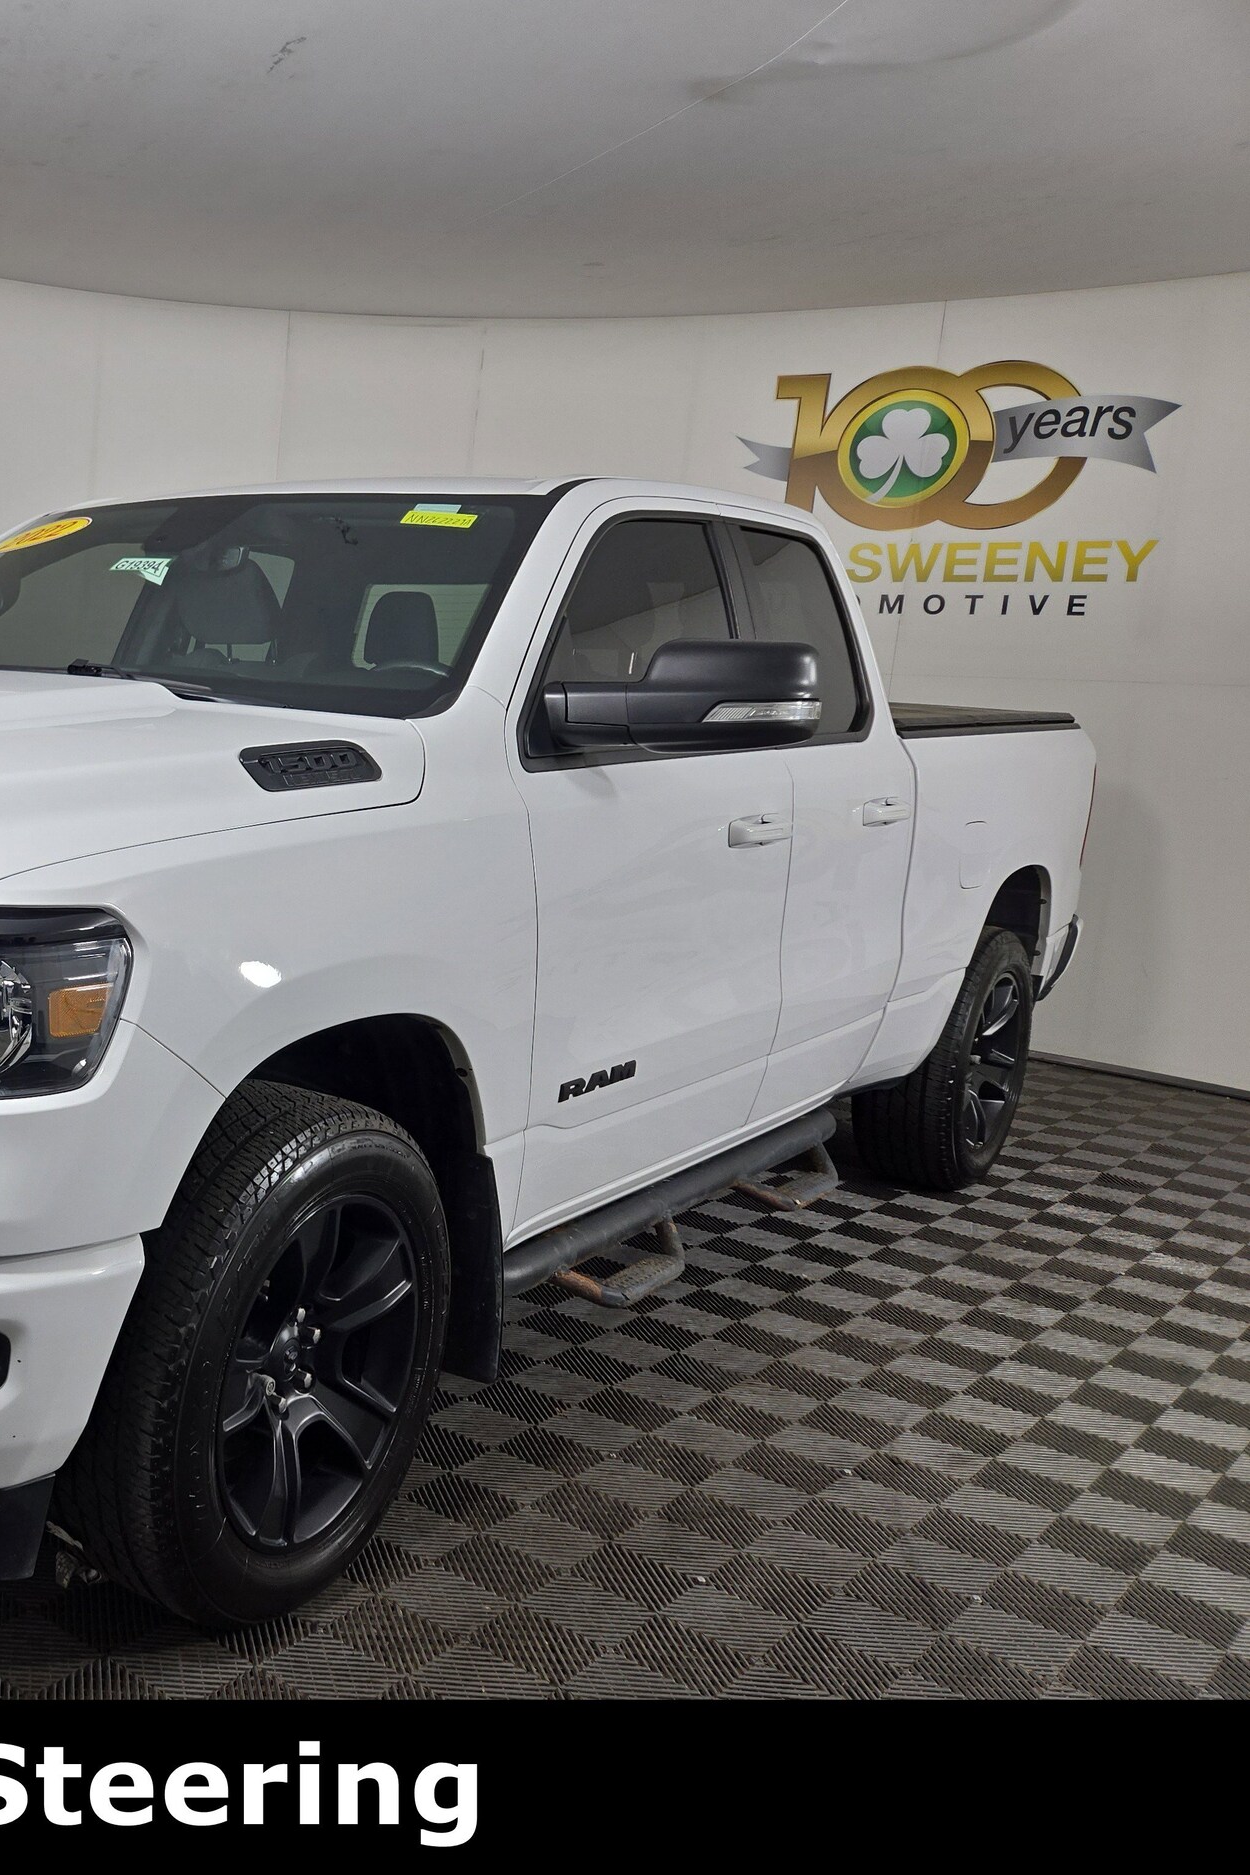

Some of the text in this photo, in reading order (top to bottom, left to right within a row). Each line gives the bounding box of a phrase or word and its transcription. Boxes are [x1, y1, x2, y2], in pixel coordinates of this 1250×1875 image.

[1003, 403, 1137, 454] years
[115, 560, 165, 574] G19394
[845, 540, 1159, 584] SWEENEY
[855, 593, 1088, 617] MOTIVE
[259, 751, 358, 775] 1500
[557, 1059, 637, 1103] RAM
